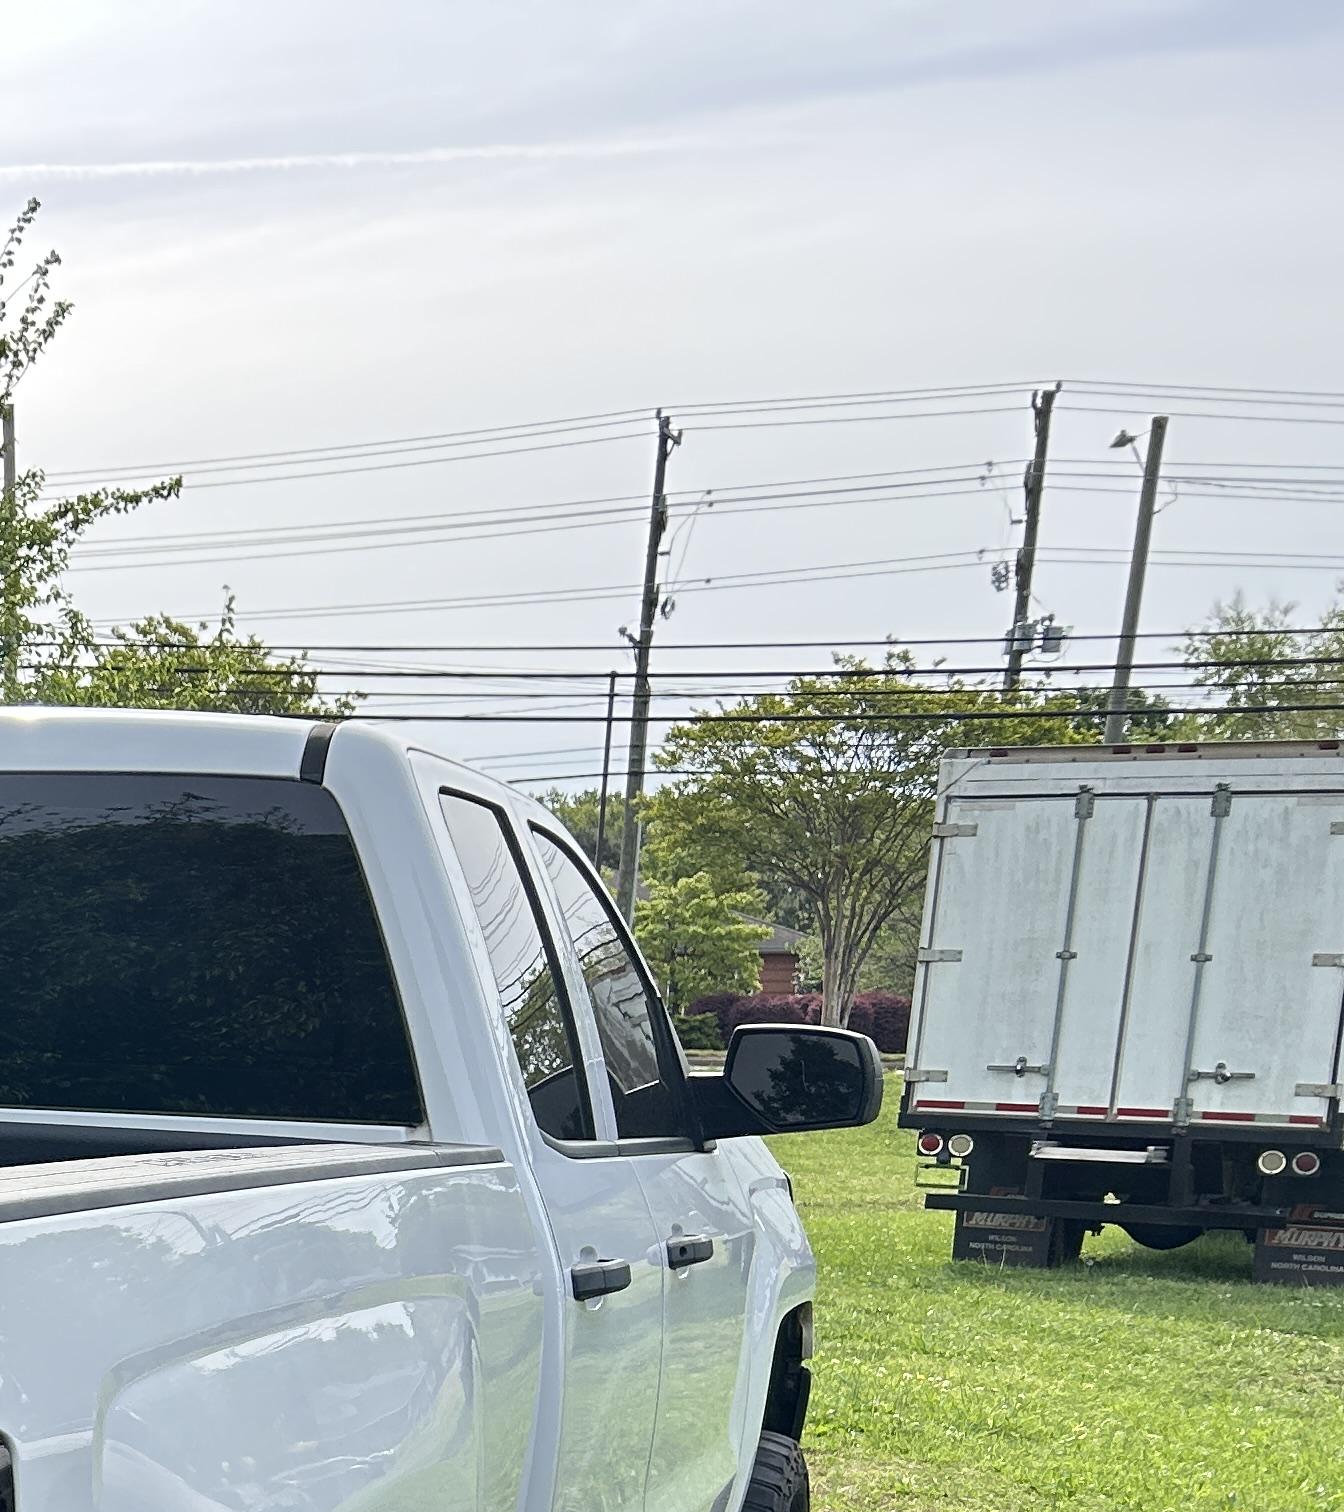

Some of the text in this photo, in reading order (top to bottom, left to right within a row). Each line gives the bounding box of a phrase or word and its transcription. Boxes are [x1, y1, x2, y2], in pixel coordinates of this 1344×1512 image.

[995, 1243, 1032, 1251] CAROLINA
[1292, 1253, 1325, 1262] WILSON
[1271, 1261, 1300, 1270] NORTH
